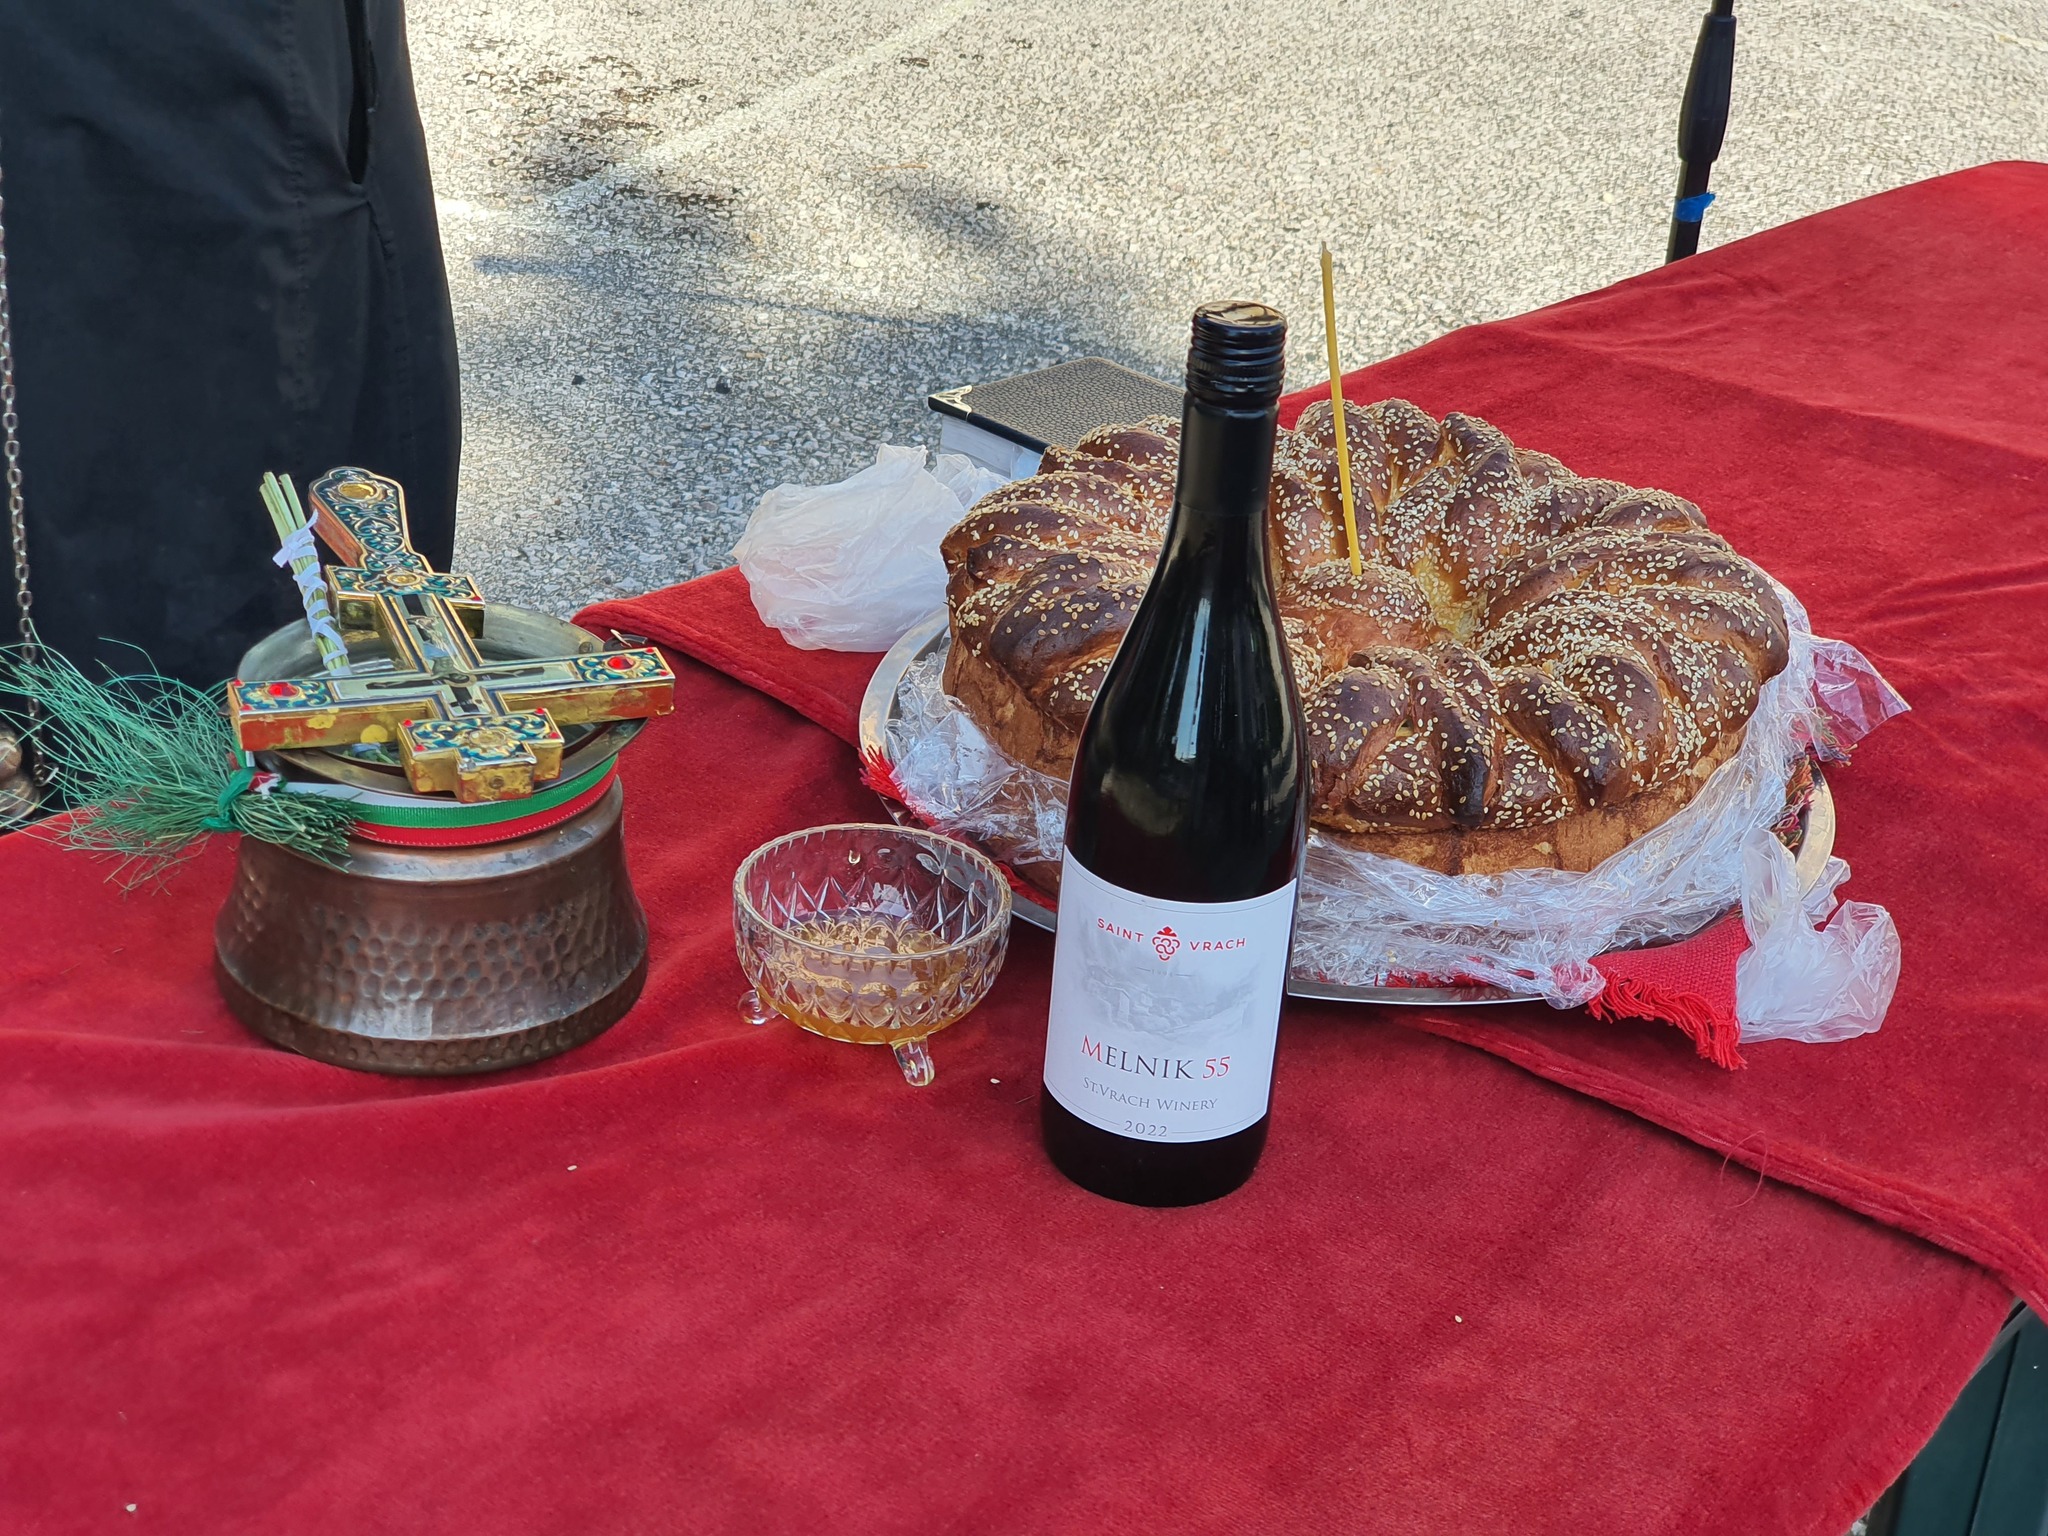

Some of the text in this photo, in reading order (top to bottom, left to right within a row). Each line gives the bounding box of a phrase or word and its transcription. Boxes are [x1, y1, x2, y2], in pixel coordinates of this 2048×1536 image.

[1097, 918, 1246, 951] SAINT VRACH
[1081, 1035, 1231, 1080] MELNIK 55
[1156, 1098, 1218, 1111] WINERY
[1124, 1120, 1168, 1137] 2022
